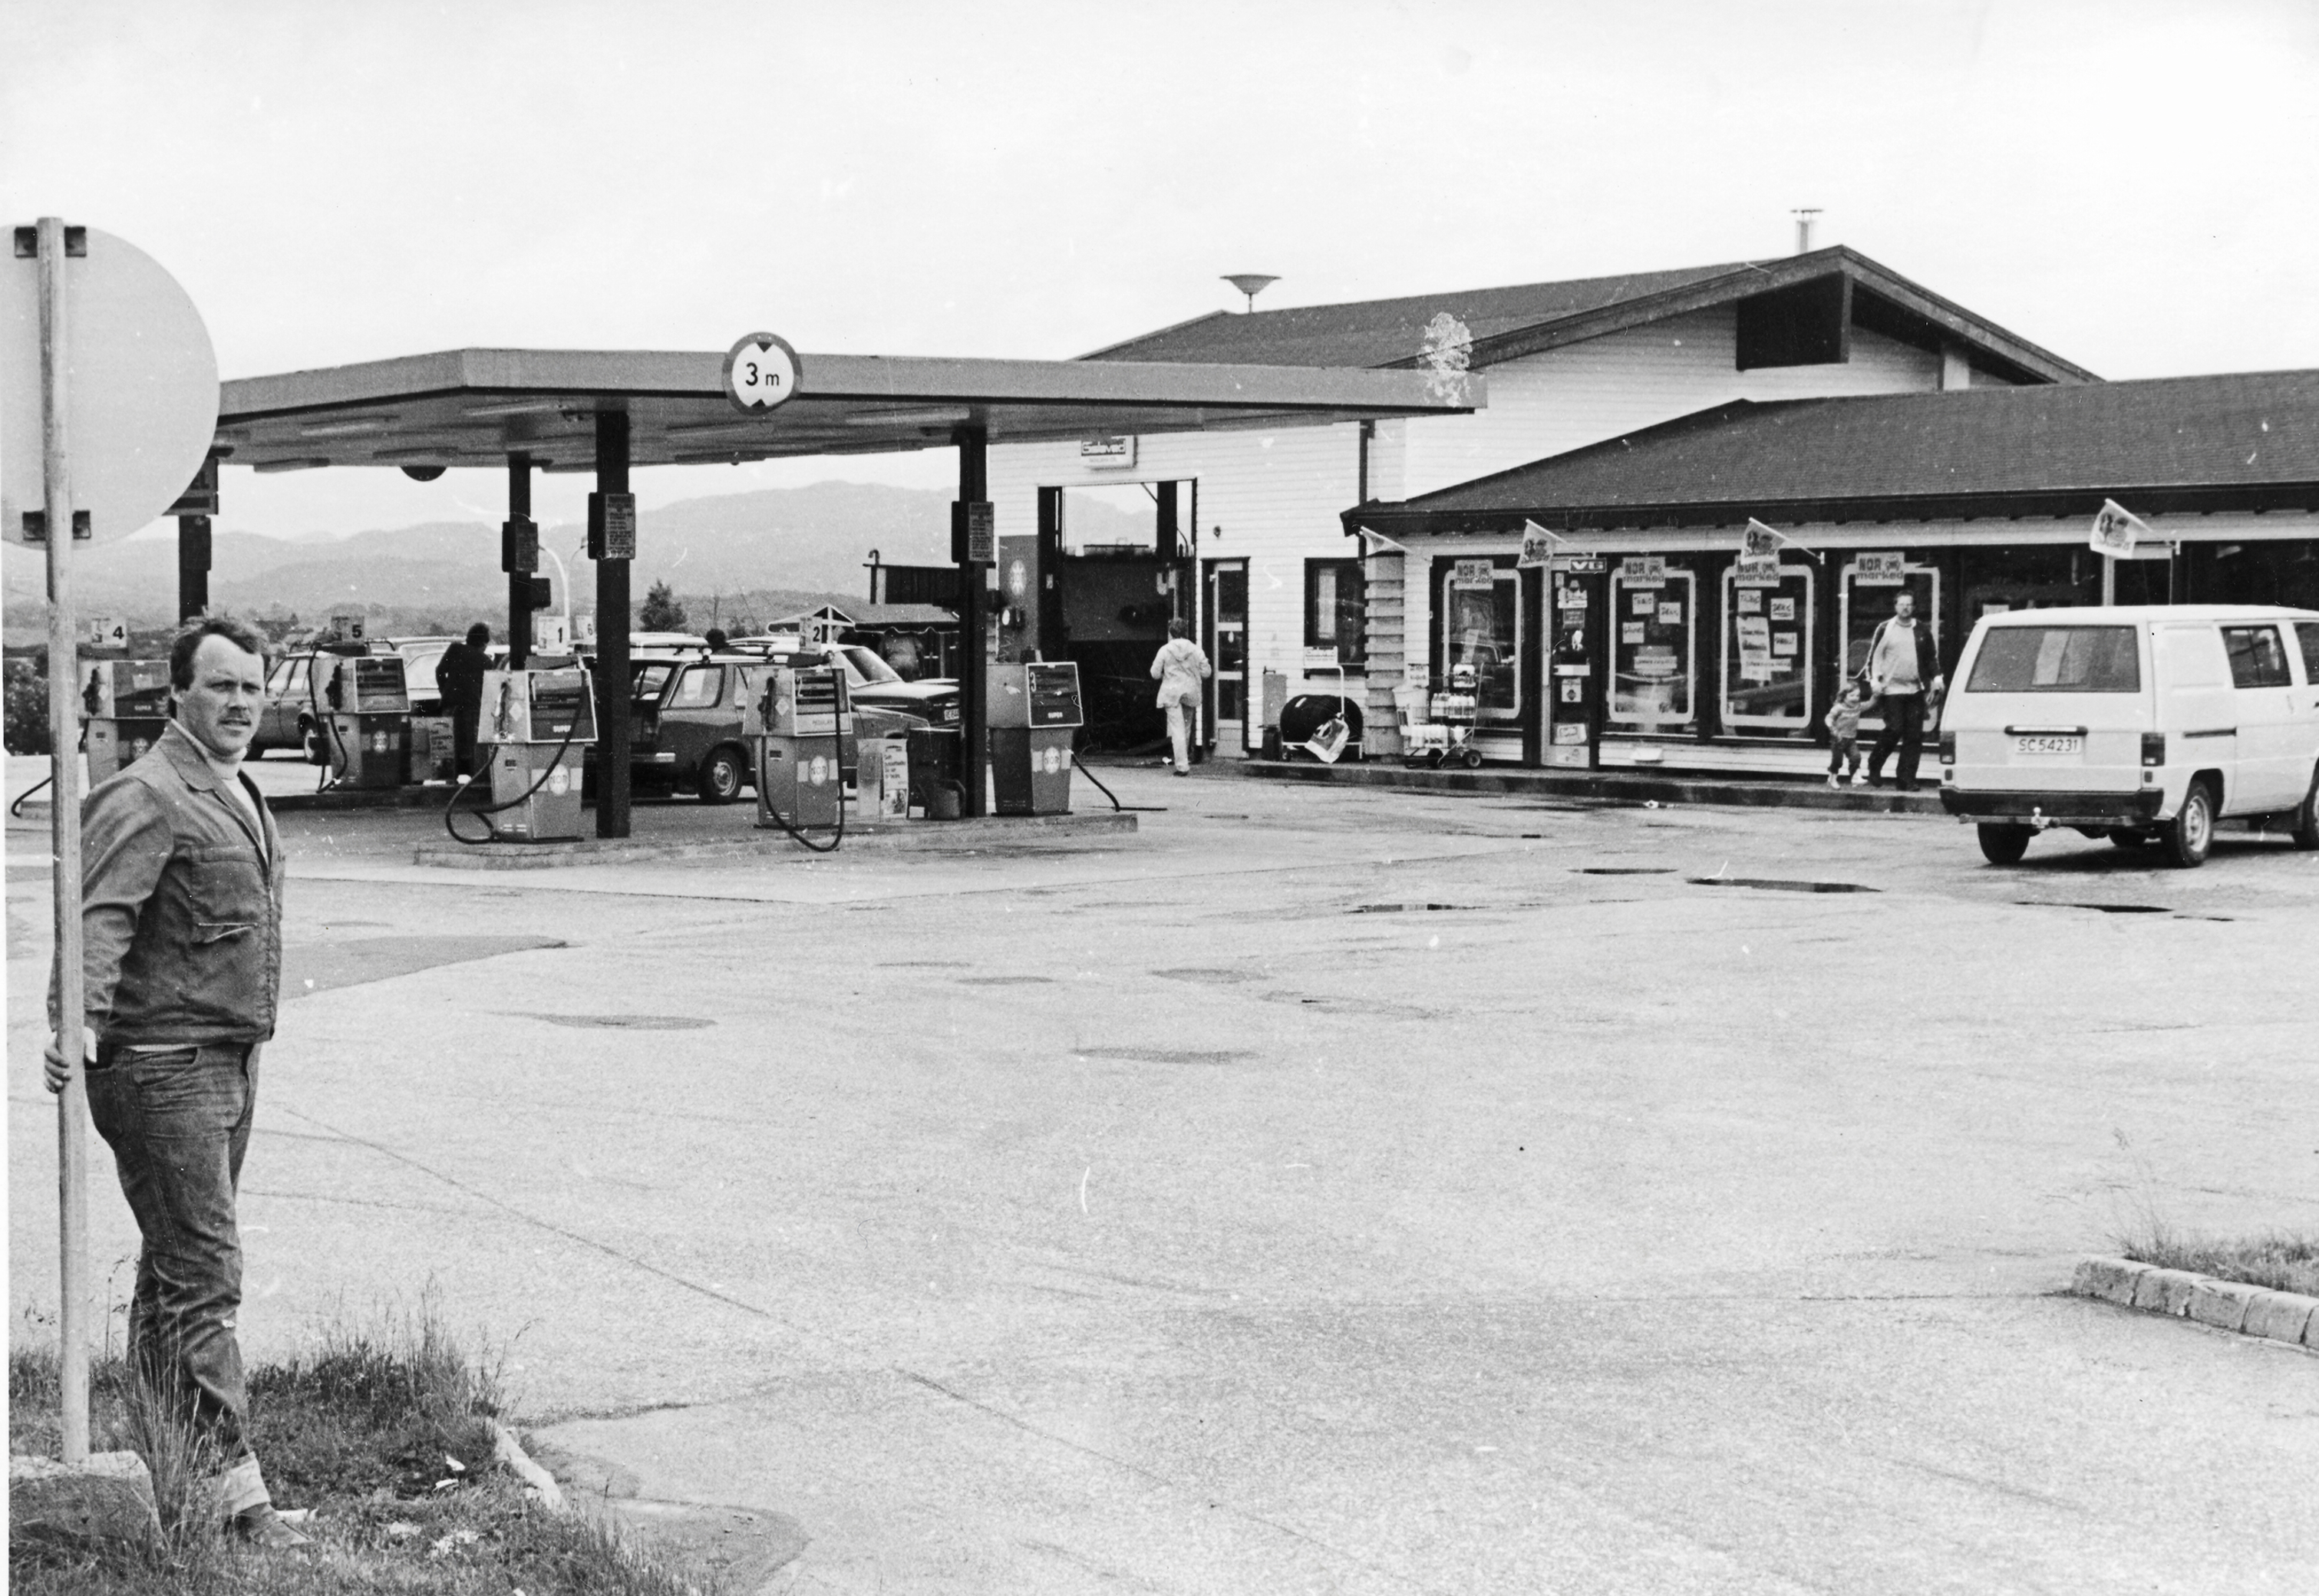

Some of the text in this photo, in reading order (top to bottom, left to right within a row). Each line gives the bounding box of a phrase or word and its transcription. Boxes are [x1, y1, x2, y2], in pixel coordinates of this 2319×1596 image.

[745, 362, 780, 387] 3 m
[1572, 561, 1604, 570] VG
[1625, 562, 1645, 575] NOR
[1859, 558, 1882, 571] NOR
[1623, 573, 1664, 583] marked
[1735, 572, 1779, 582] marked
[1857, 569, 1903, 579] marked
[112, 626, 125, 640] 4
[351, 625, 362, 638] 5
[558, 626, 562, 644] 1
[587, 623, 593, 636] 6
[813, 625, 820, 642] 2
[1029, 671, 1037, 692] 3
